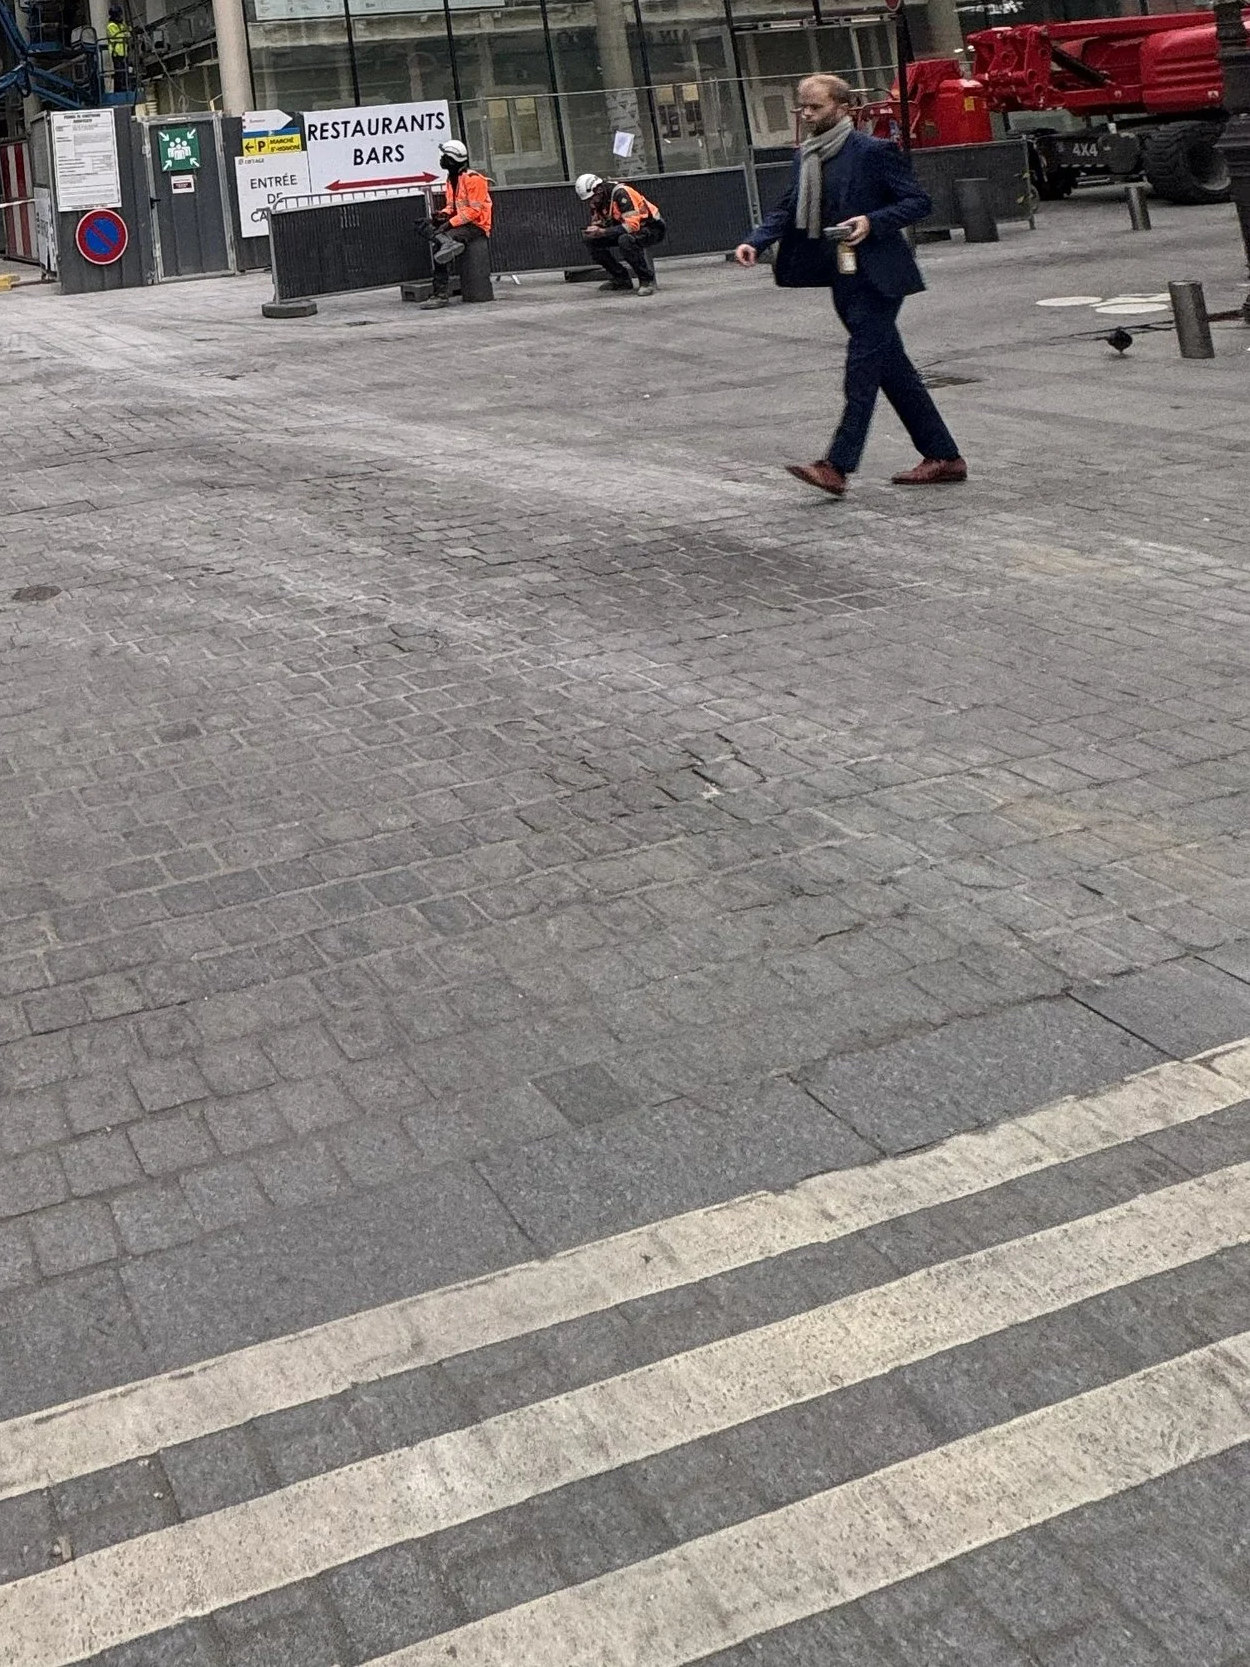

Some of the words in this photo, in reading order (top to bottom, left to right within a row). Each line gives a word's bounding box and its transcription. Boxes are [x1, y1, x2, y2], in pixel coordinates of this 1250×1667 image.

[307, 112, 445, 141] RESTAURANTS
[257, 140, 266, 152] P
[353, 144, 405, 166] BARS
[250, 172, 298, 189] ENTRÉE
[267, 192, 284, 205] DE
